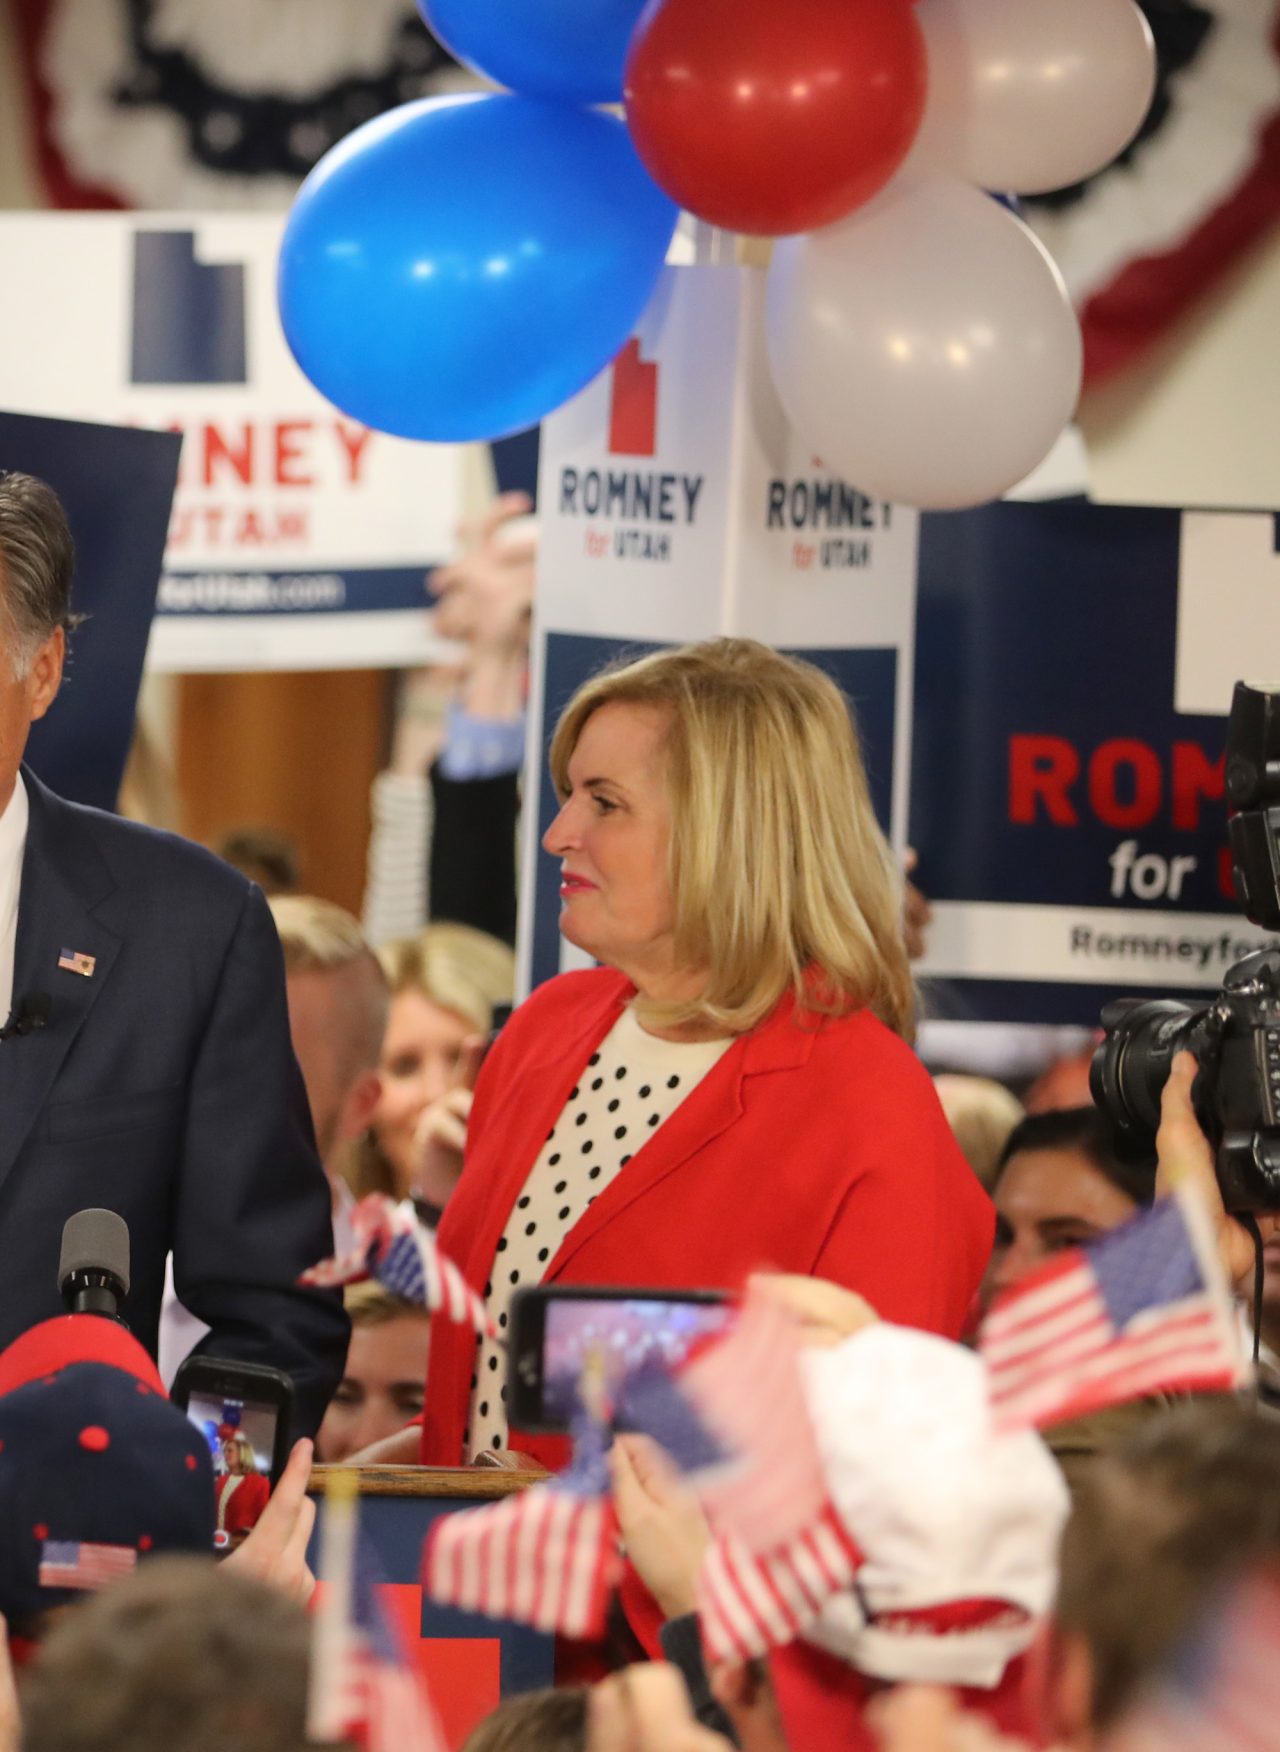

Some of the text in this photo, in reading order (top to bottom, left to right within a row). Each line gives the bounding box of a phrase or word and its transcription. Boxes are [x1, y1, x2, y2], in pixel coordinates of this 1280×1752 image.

[170, 416, 375, 487] NEY
[559, 468, 704, 524] ROMNEY
[1108, 838, 1198, 901] for
